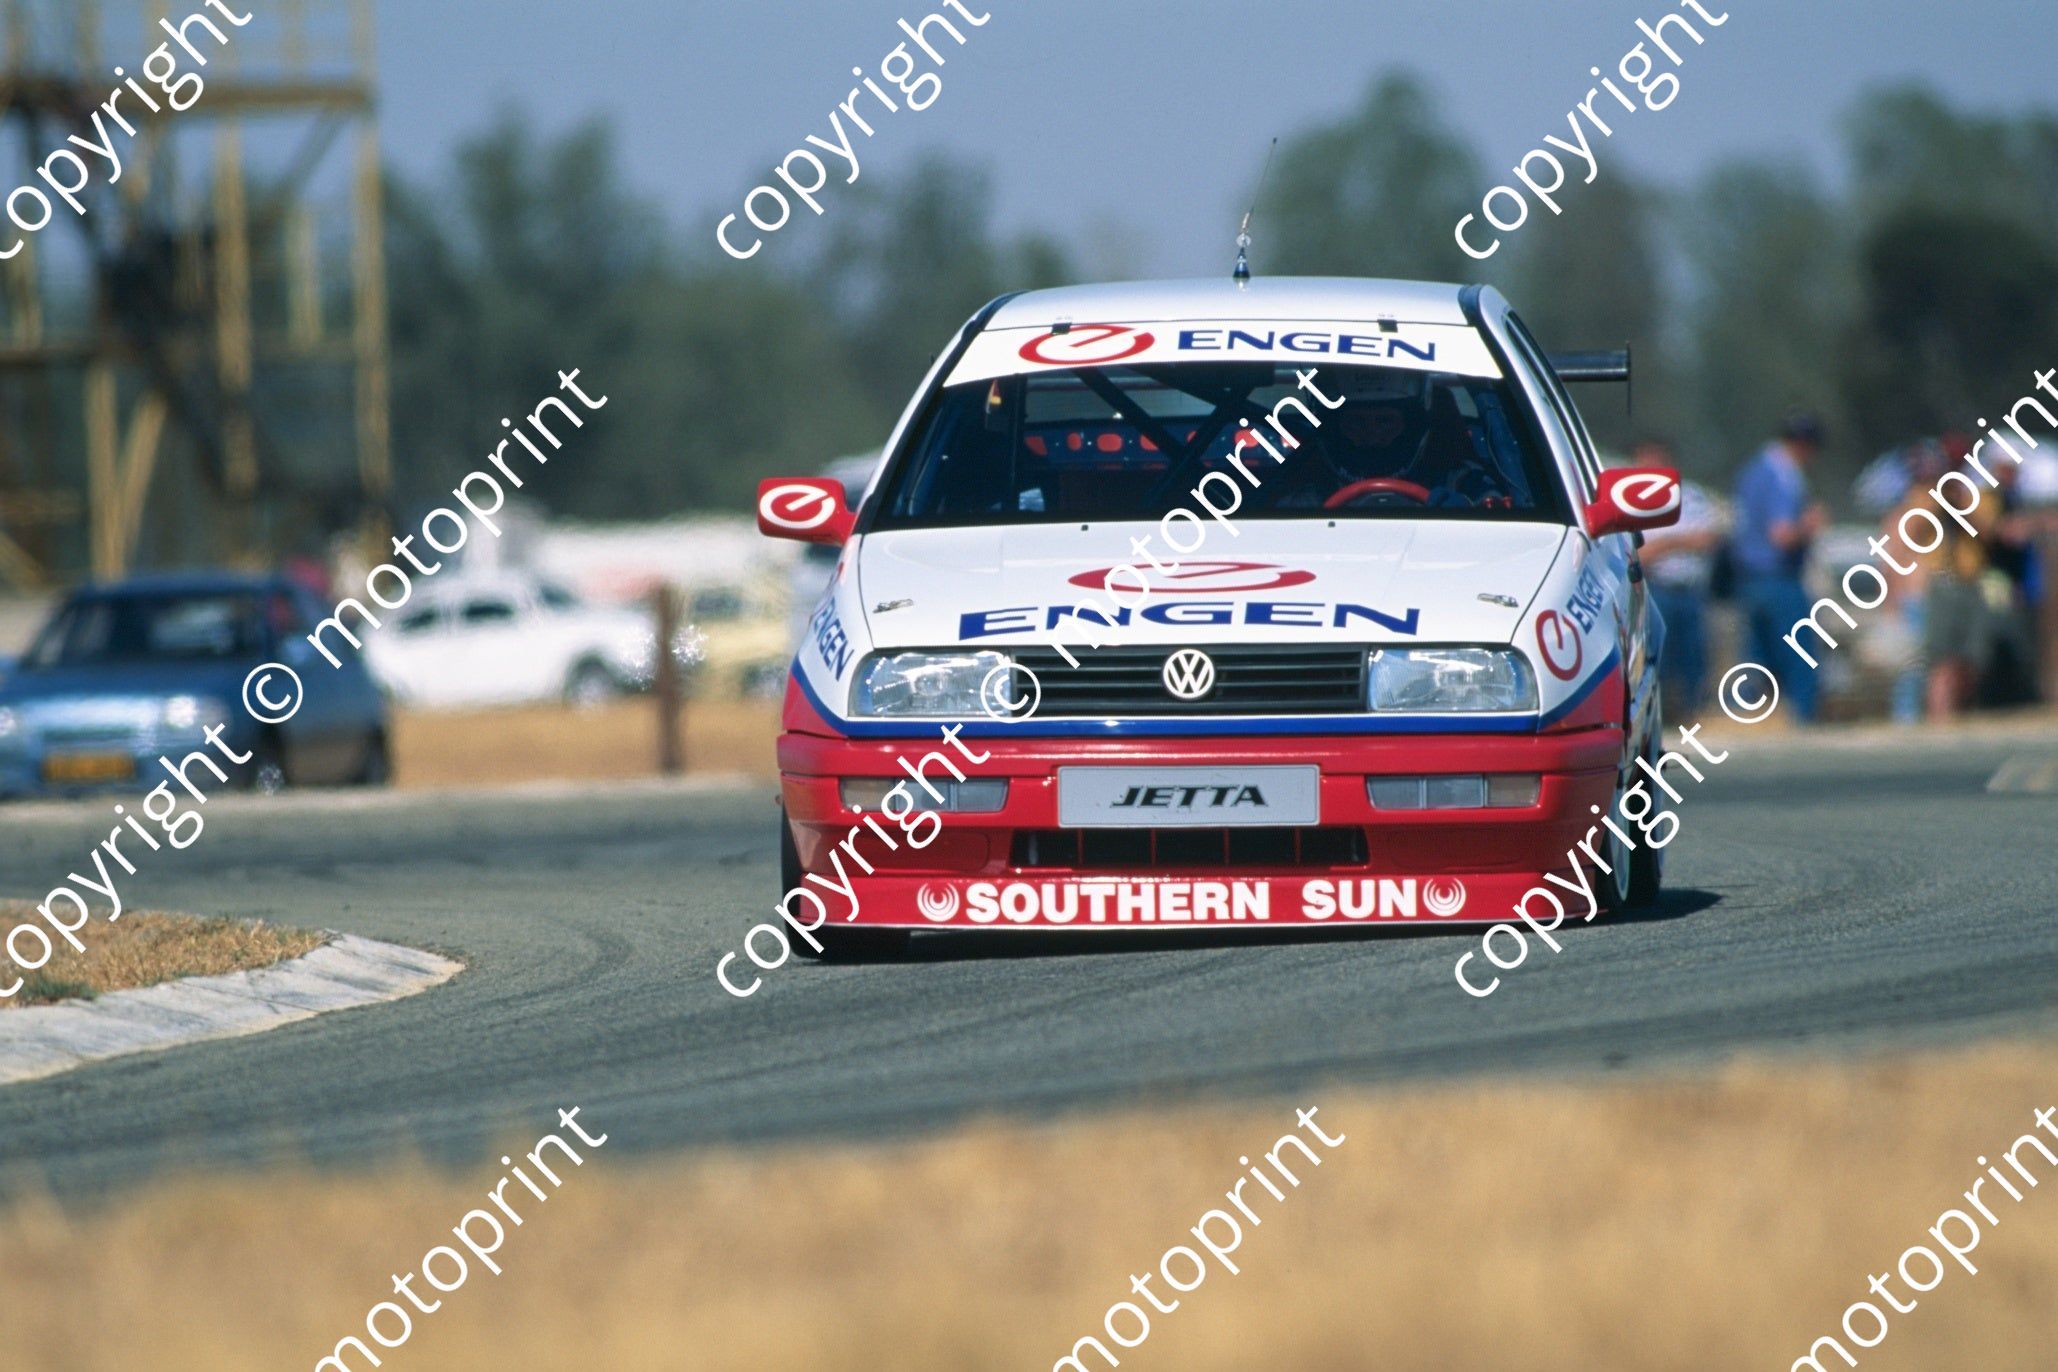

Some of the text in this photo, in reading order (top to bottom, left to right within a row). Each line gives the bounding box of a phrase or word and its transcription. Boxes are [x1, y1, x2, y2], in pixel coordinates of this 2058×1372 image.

[1178, 329, 1436, 361] ENGEN
[958, 601, 1420, 641] ENGEN
[1110, 783, 1267, 808] JETTA
[966, 878, 1417, 923] SOUTHERN SUN
